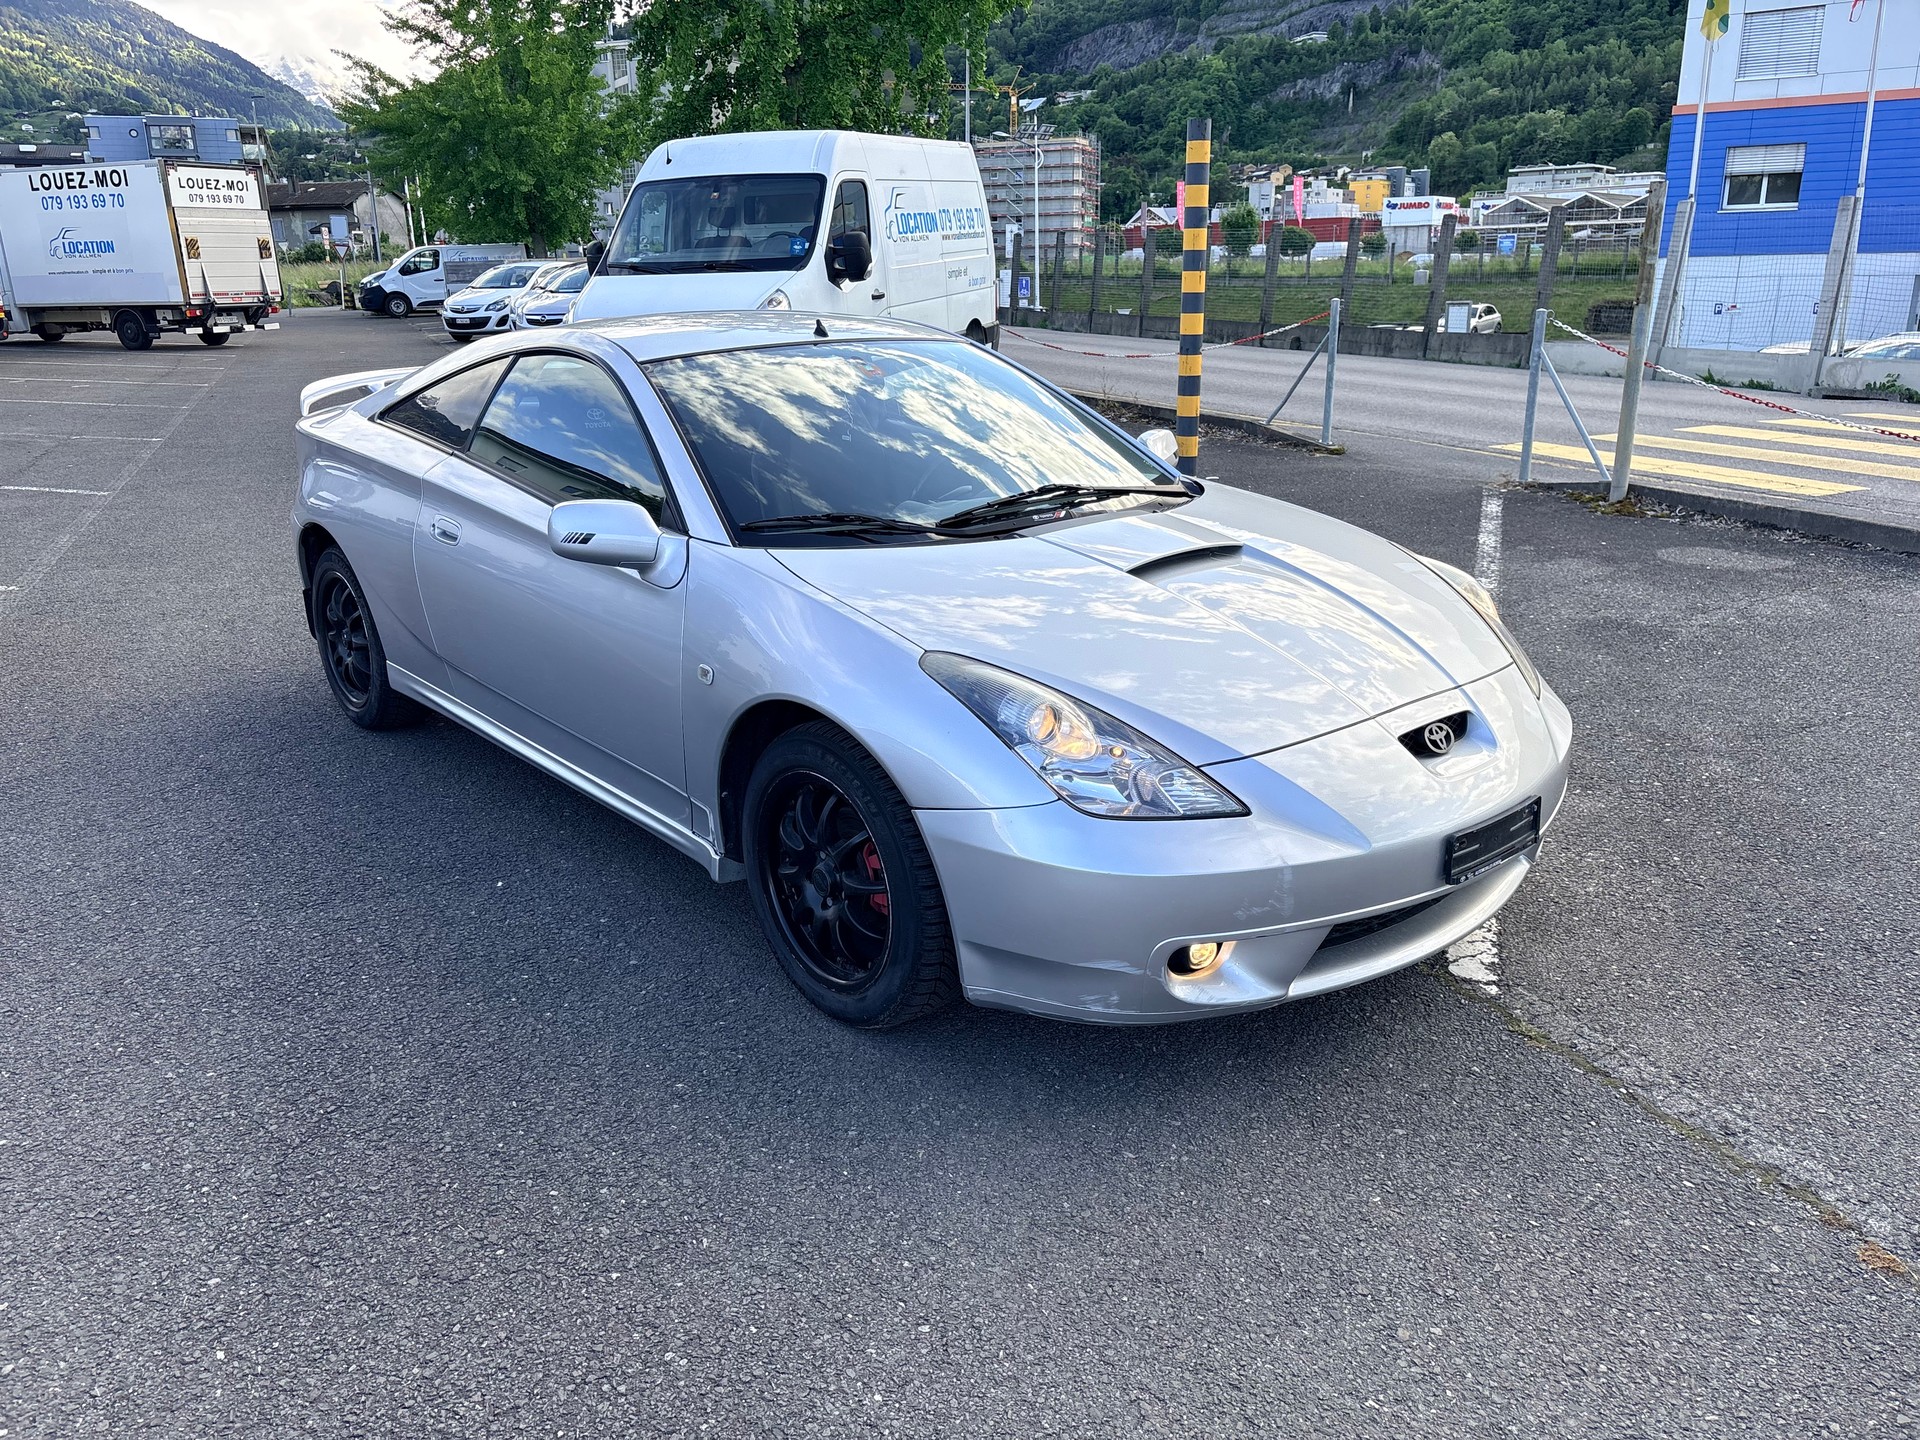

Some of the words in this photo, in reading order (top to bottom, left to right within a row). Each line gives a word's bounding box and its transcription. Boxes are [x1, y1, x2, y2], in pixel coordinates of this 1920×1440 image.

[28, 169, 129, 191] LOUEZ-MOI
[178, 177, 249, 192] LOUEZ-MOI
[41, 196, 63, 211] 079
[66, 194, 88, 209] 193
[91, 193, 106, 208] 69
[108, 193, 125, 208] 70
[188, 193, 204, 203] 079
[206, 194, 221, 203] 193
[222, 194, 233, 204] 69
[234, 194, 244, 204] 70
[1398, 201, 1430, 210] JUMBO
[895, 211, 938, 235] LOCATION
[939, 208, 953, 232] 079
[953, 208, 966, 230] 193
[965, 208, 975, 230] 69
[898, 235, 910, 243] VON
[910, 234, 930, 242] ALLMEN
[62, 240, 115, 254] LOCATION
[947, 266, 963, 280] simple
[963, 266, 968, 277] et
[584, 421, 611, 429] TOYOTA
